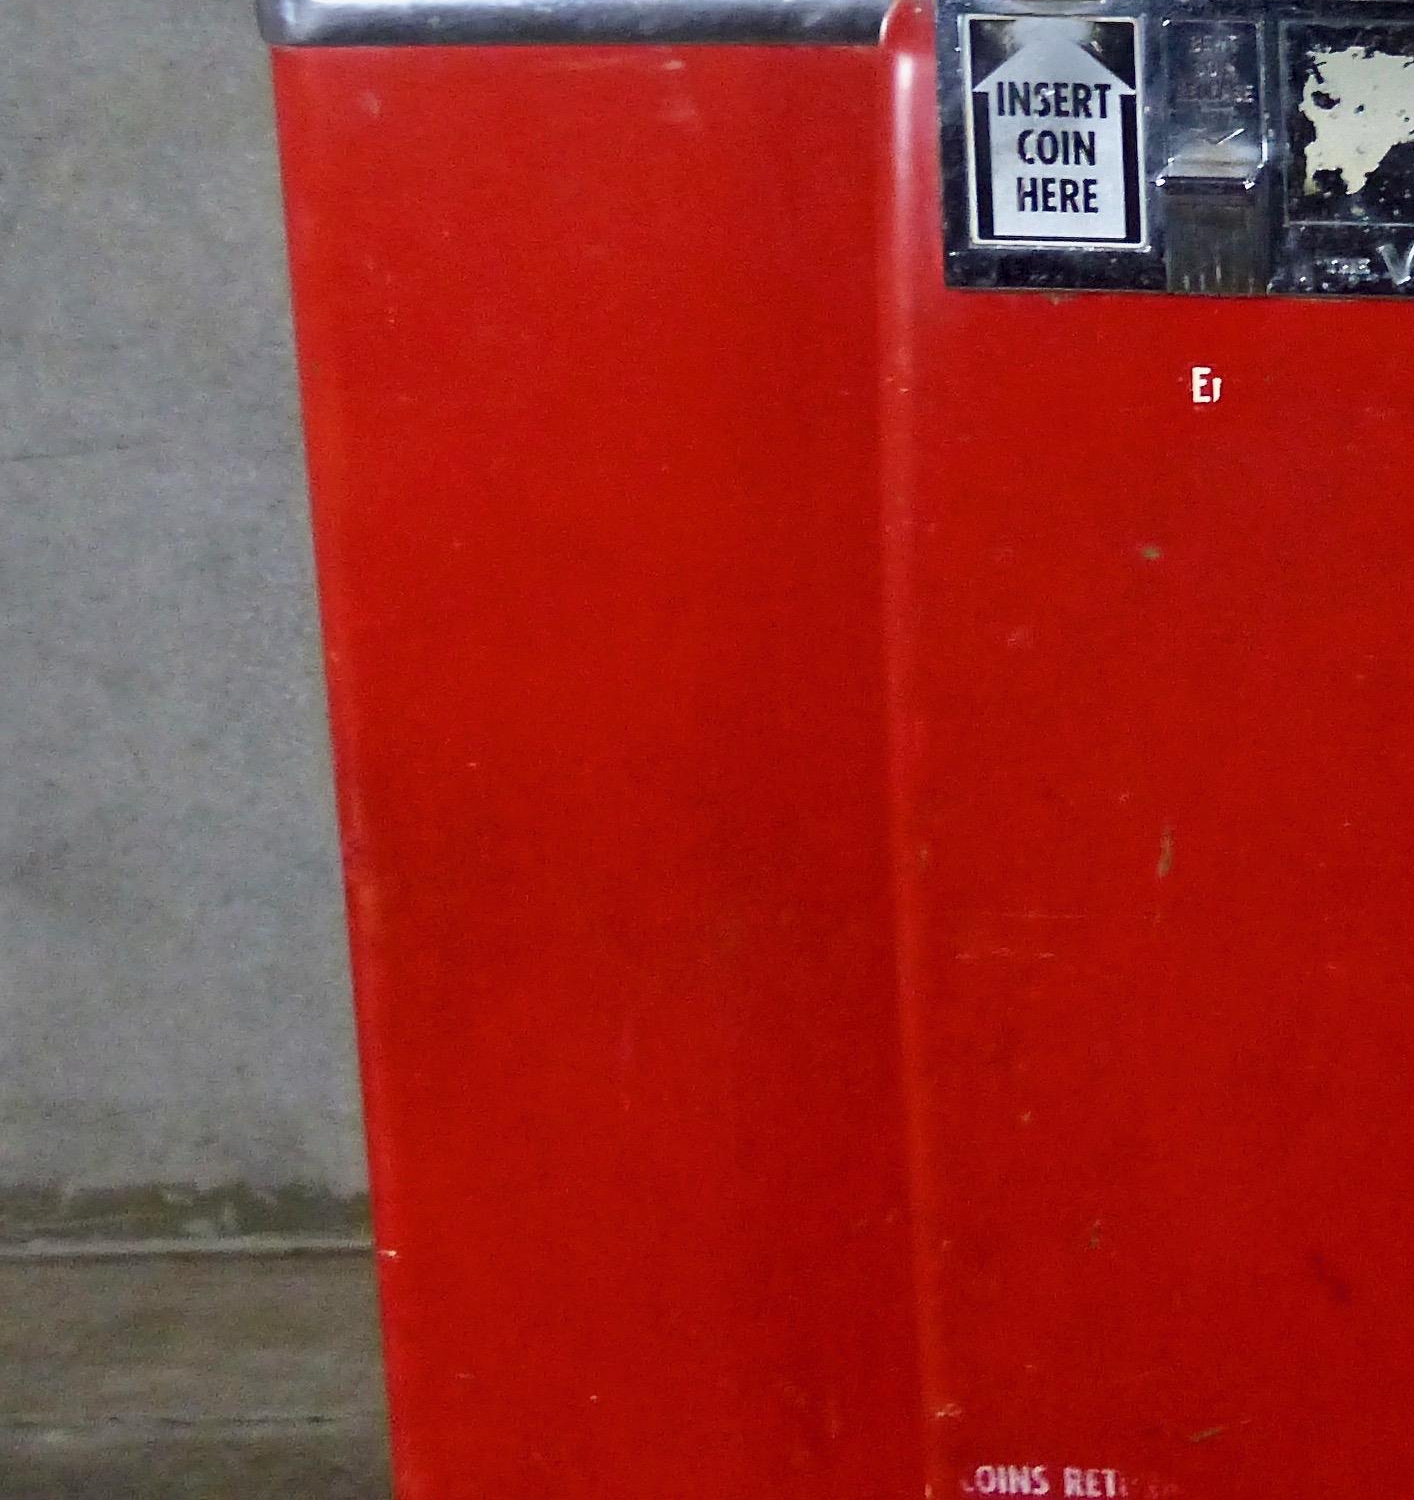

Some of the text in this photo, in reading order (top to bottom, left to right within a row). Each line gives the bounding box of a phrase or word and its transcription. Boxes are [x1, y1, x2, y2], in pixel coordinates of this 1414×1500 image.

[997, 81, 1111, 118] INSERT
[1017, 129, 1095, 166] COIN
[1016, 177, 1099, 213] HERE
